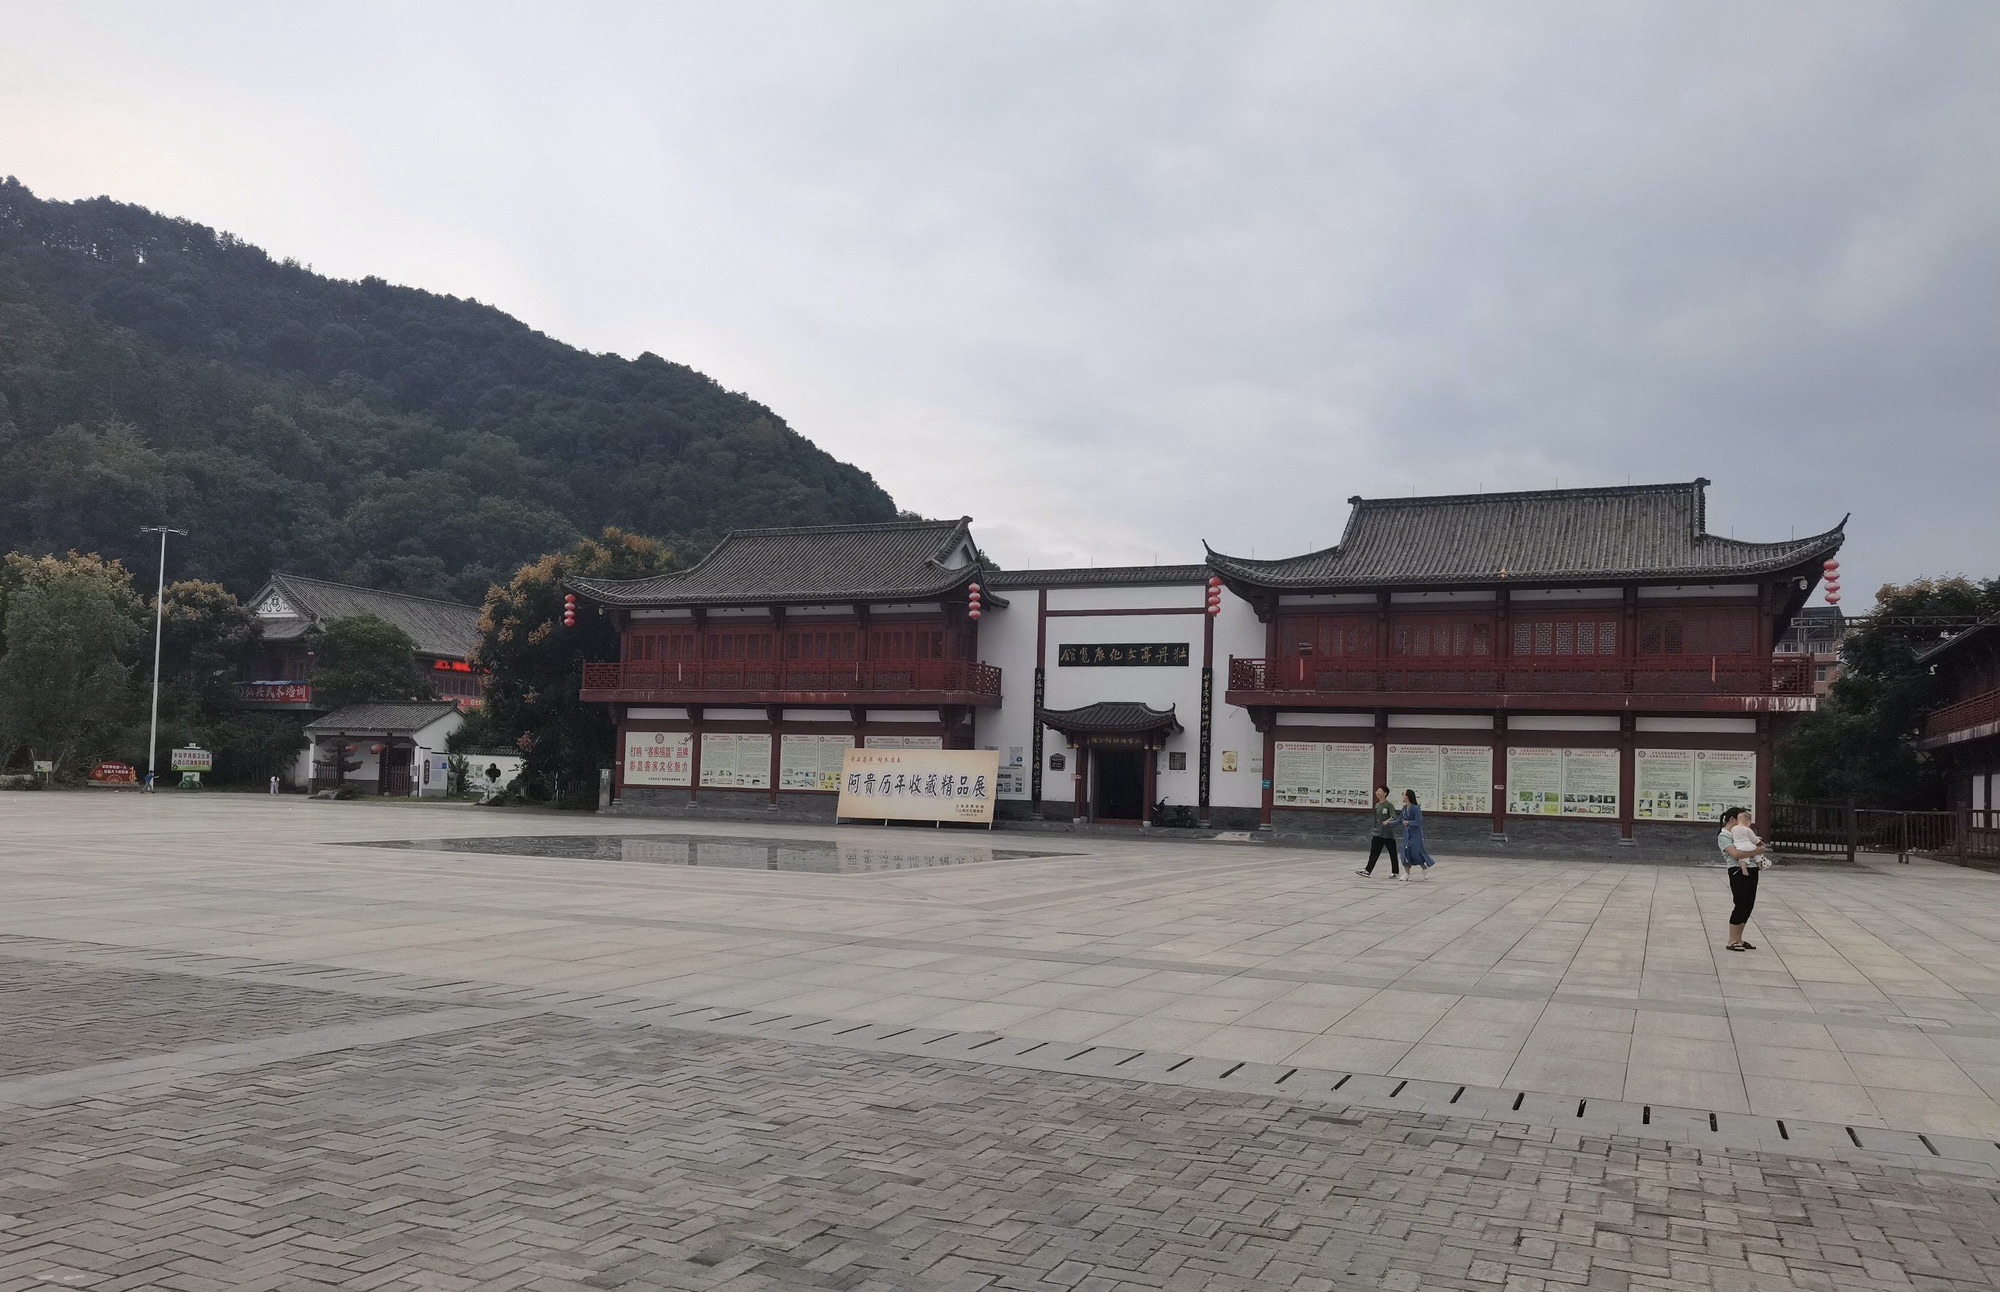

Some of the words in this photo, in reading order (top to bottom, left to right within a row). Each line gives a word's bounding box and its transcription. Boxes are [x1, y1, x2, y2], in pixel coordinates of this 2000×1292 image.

[847, 772, 986, 797] 阿贵历年收藏精品展
